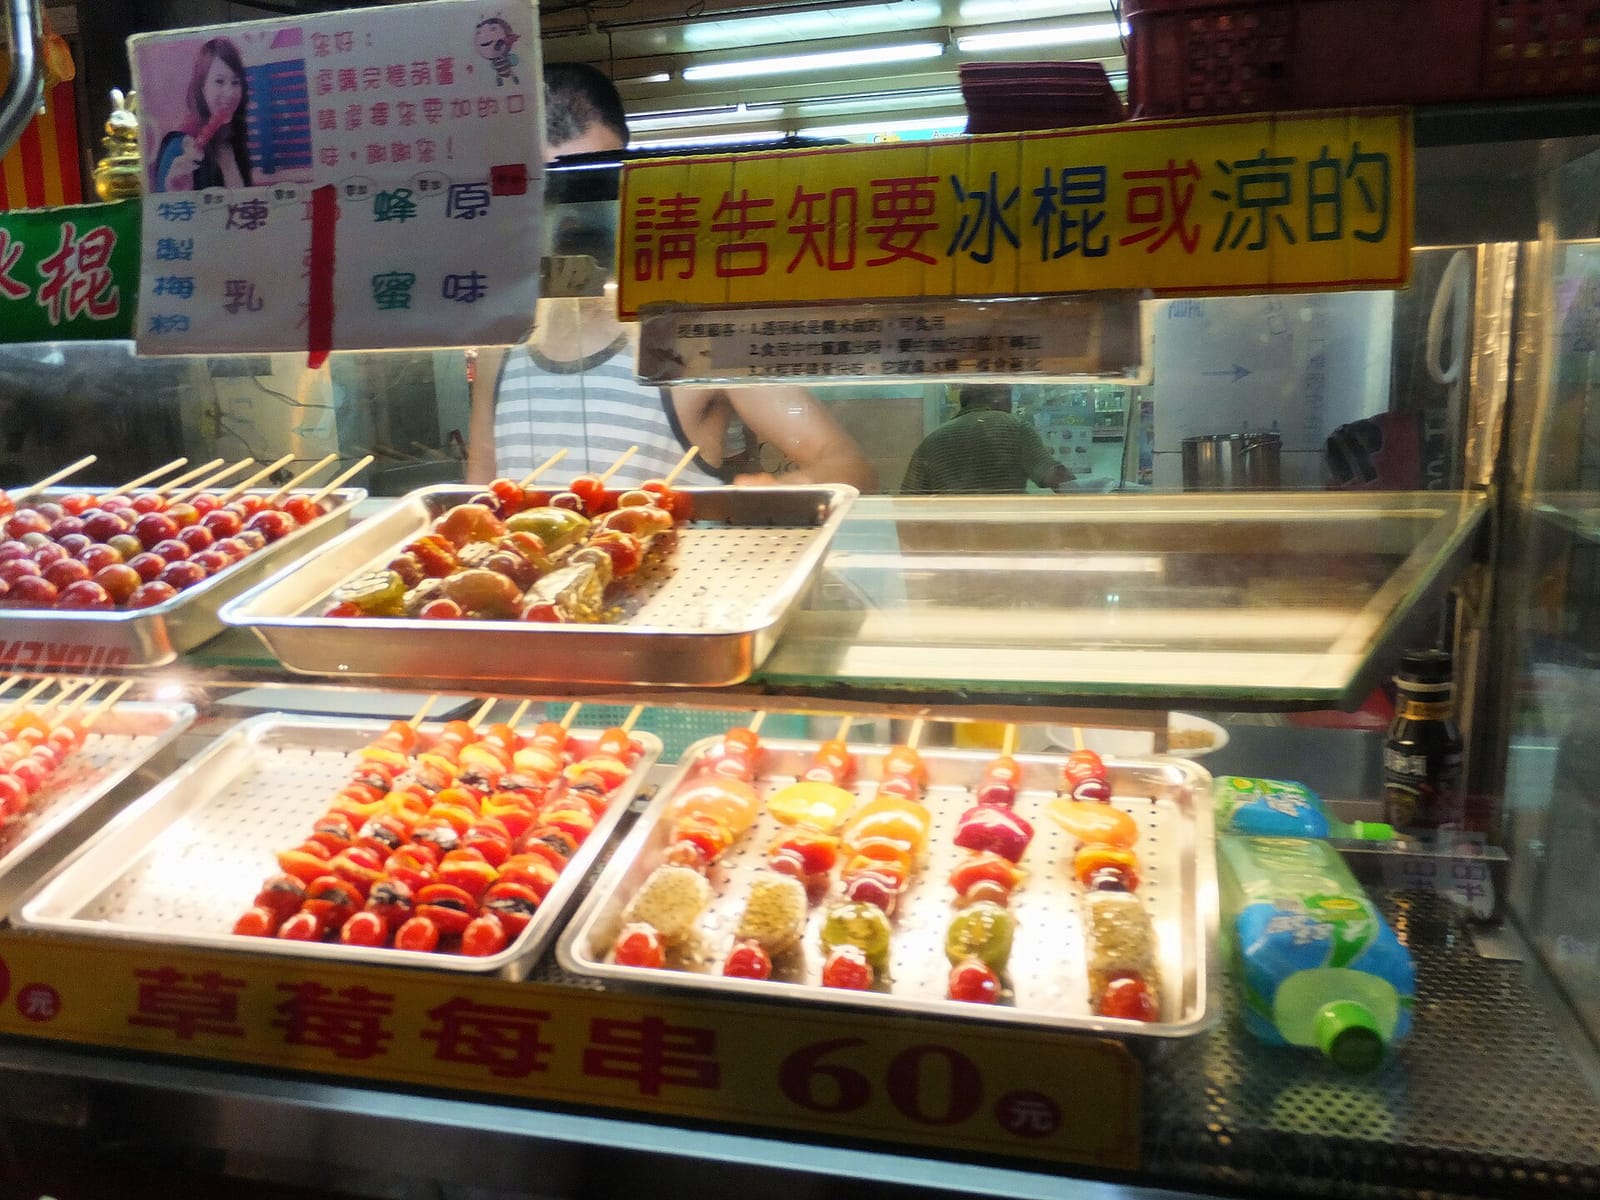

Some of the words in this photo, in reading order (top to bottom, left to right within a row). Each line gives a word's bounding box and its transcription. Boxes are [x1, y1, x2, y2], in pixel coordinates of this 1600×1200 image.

[223, 198, 269, 315] 煉乳
[372, 187, 417, 310] 蜂蜜
[442, 182, 490, 304] 原味
[634, 142, 1390, 283] 請告知要冰棍或涼的
[127, 966, 1058, 1134] 草莓每串60元
